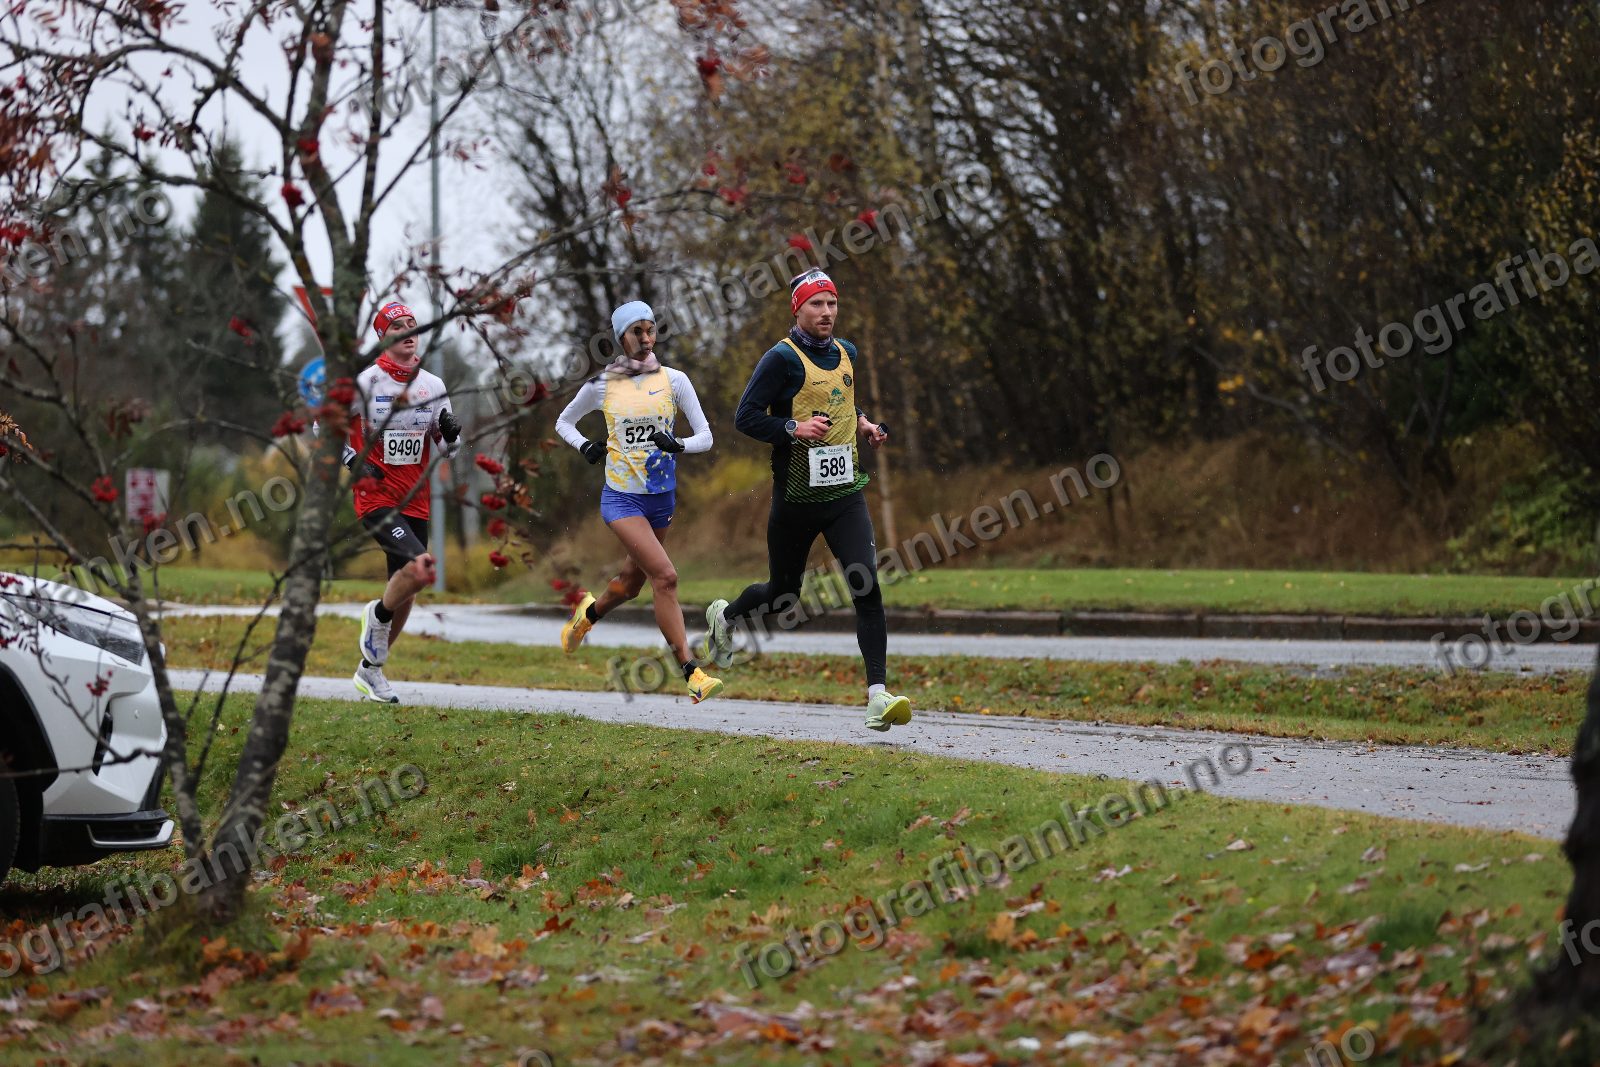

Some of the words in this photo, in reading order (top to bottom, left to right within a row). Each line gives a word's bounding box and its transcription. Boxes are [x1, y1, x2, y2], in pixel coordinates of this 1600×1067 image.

[625, 424, 656, 445] 522
[388, 438, 421, 457] 9490
[820, 455, 846, 478] 589
